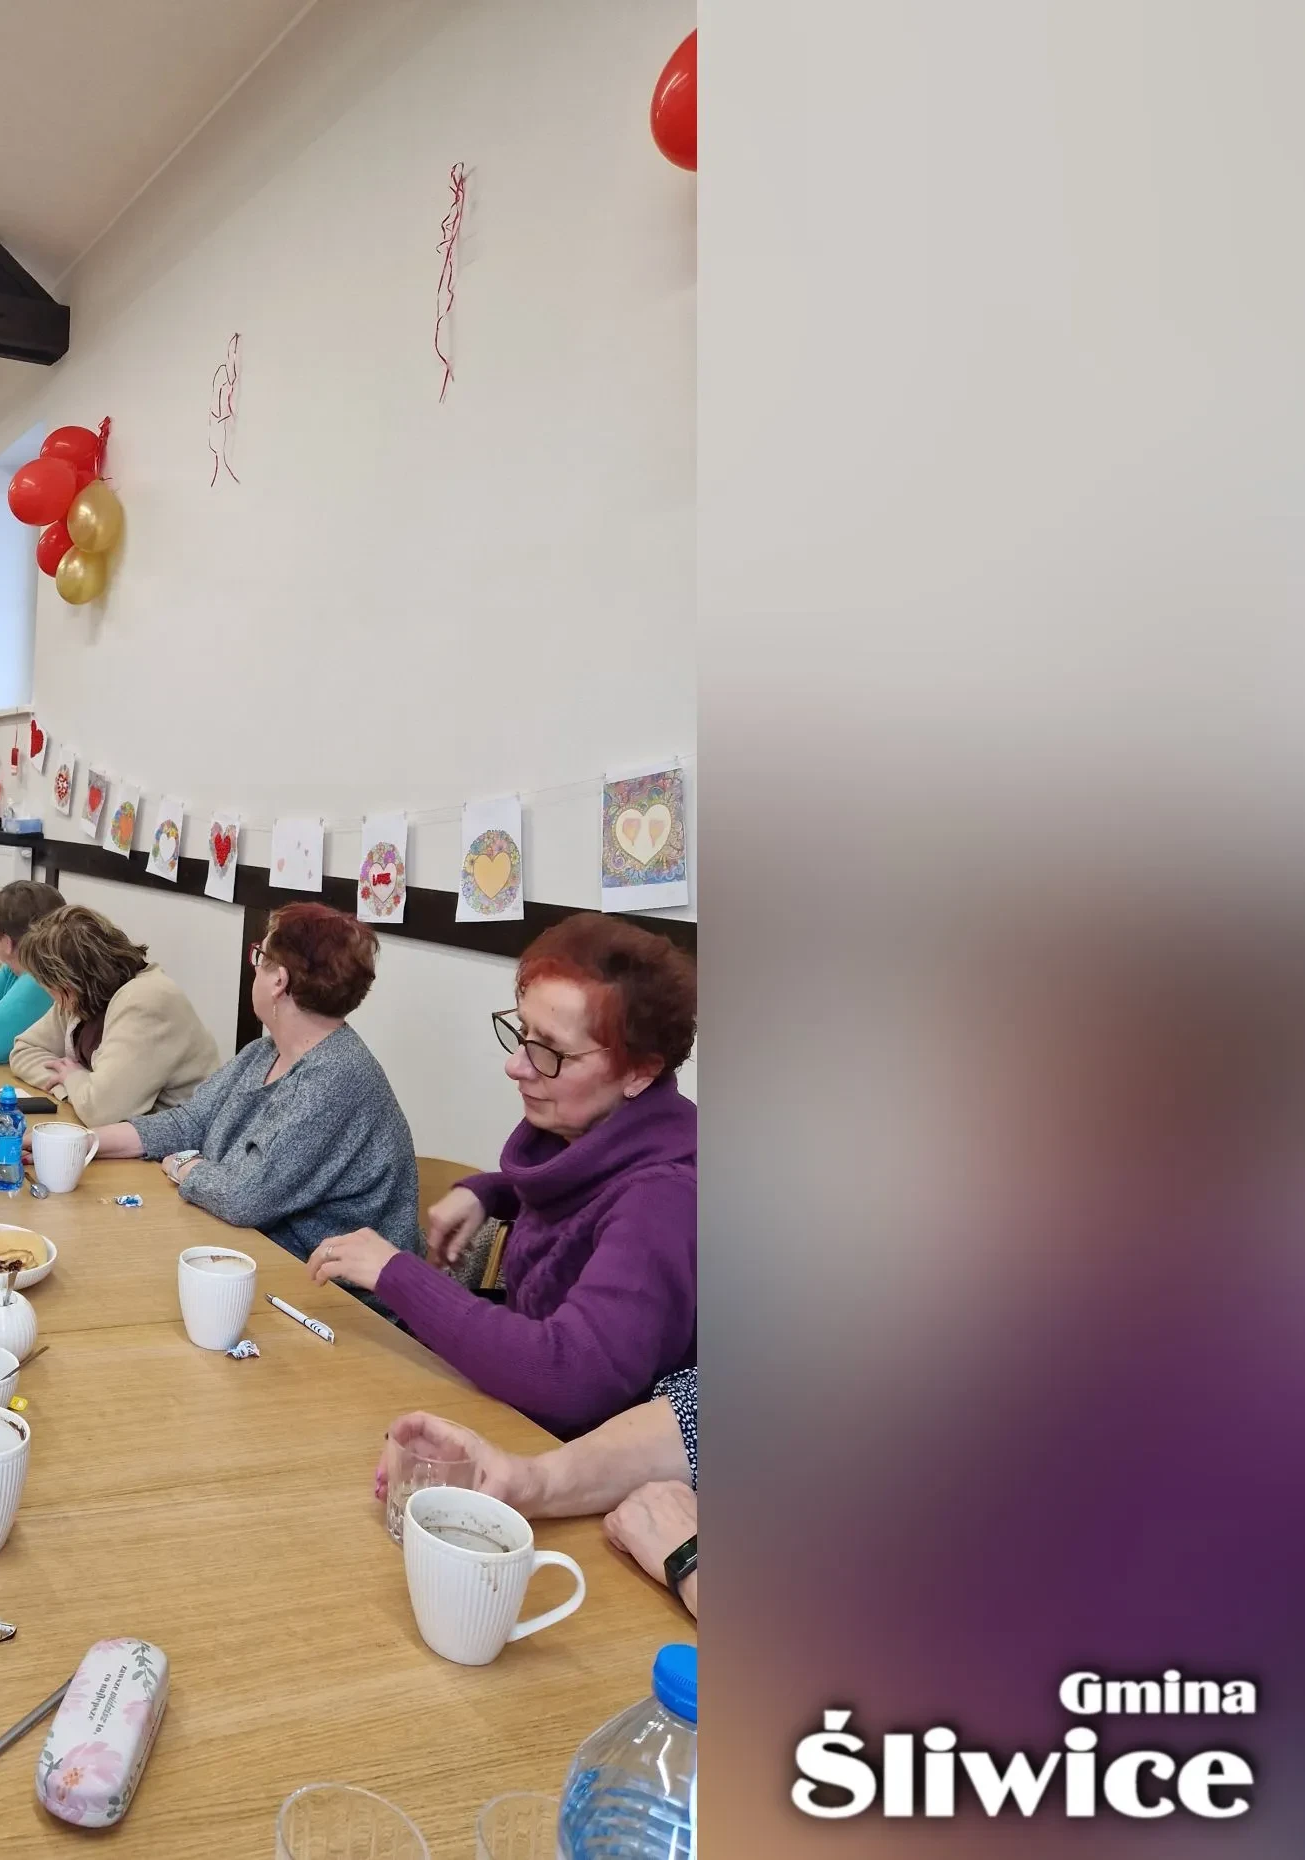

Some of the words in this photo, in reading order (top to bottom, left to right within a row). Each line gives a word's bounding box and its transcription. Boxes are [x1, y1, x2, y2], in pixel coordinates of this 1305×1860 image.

[103, 1673, 112, 1682] co
[111, 1665, 128, 1691] zawsze
[88, 1683, 108, 1721] najlepsze
